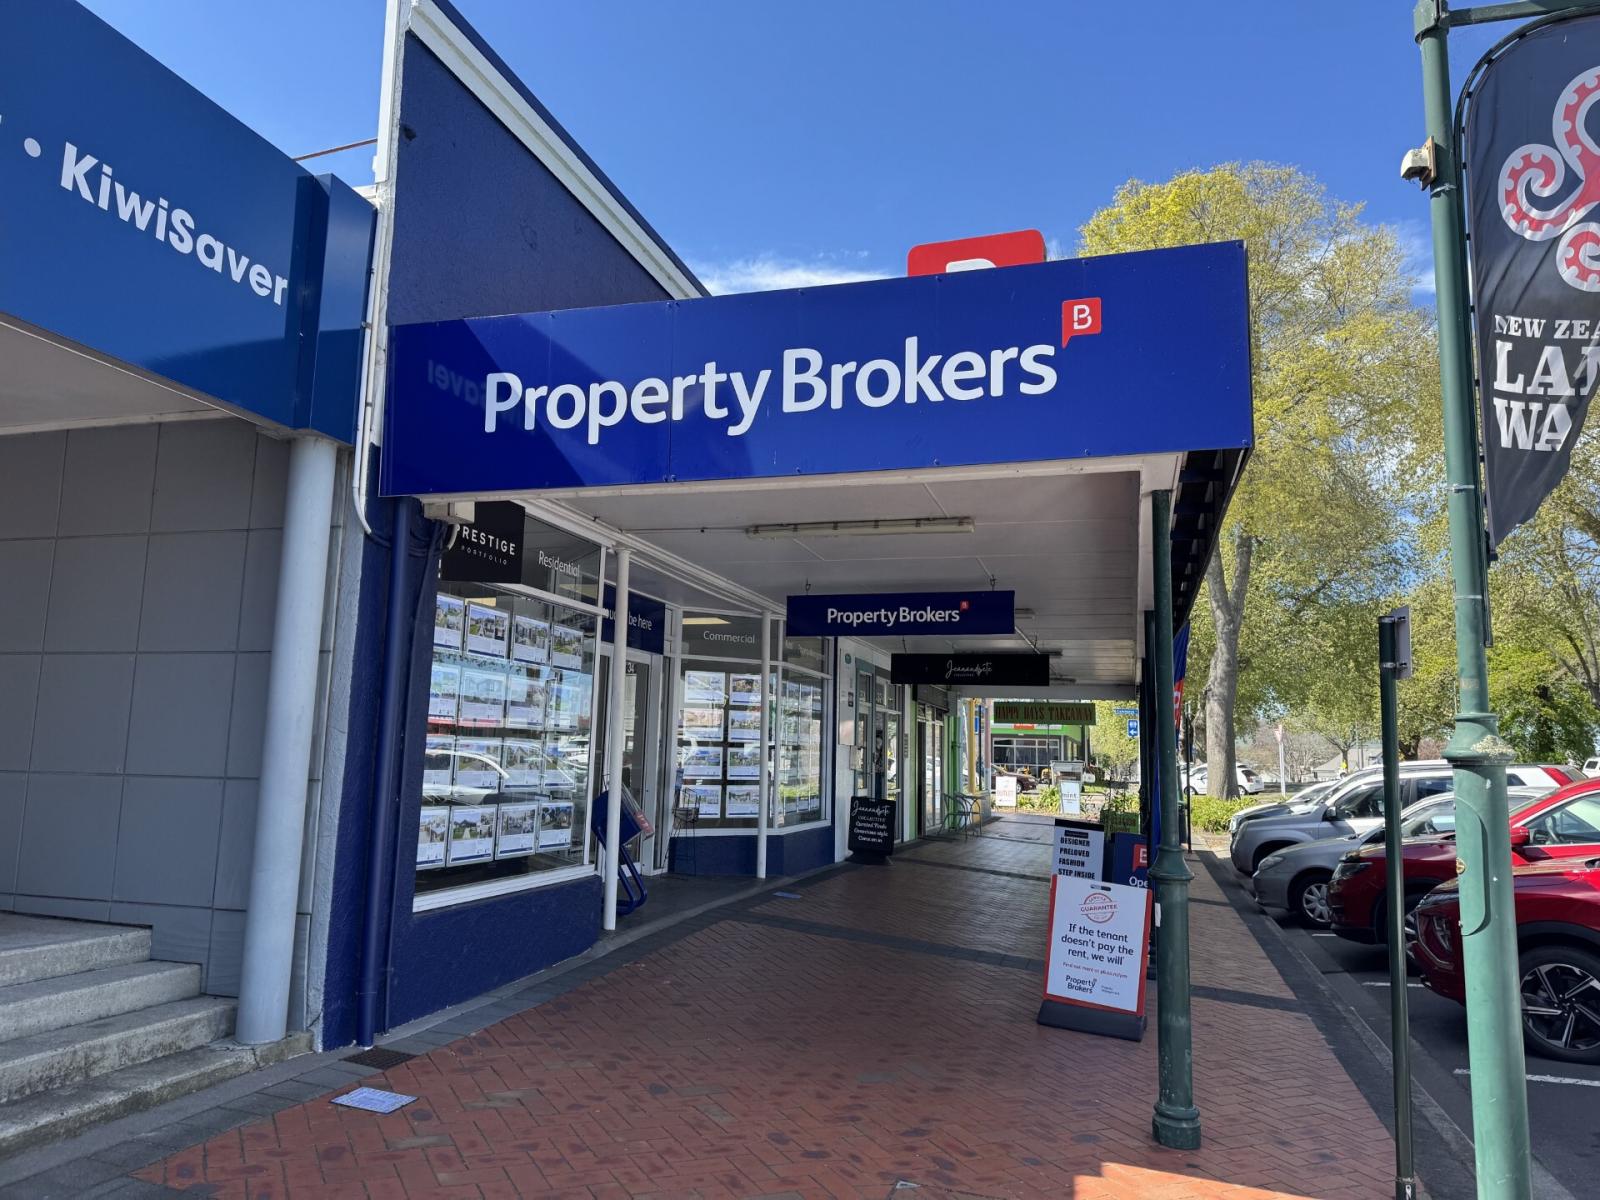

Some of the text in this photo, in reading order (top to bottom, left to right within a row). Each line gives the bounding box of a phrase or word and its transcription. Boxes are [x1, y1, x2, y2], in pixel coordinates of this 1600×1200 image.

[60, 141, 289, 306] KiwiSaver
[1494, 314, 1547, 339] NEW
[484, 361, 772, 444] Property
[782, 336, 1057, 414] Brokers
[461, 545, 508, 566] PORTFOLIO
[538, 550, 580, 577] Residential
[628, 612, 637, 627] be
[637, 613, 653, 632] here
[827, 606, 960, 627] Property Brokers
[703, 630, 755, 644] Commercial
[1060, 836, 1090, 847] DESIGNER
[1059, 847, 1090, 857] PRELOVED
[1058, 858, 1085, 867] FASHION
[1058, 868, 1095, 879] STEP INSIDE
[1080, 903, 1118, 912] GUARANTEE
[1069, 923, 1128, 943] If the tenant
[1061, 934, 1134, 956] doesn't pay the
[1068, 948, 1089, 960] rent,
[1091, 952, 1105, 962] we
[1065, 975, 1096, 988] Property
[1067, 982, 1093, 994] Brokers
